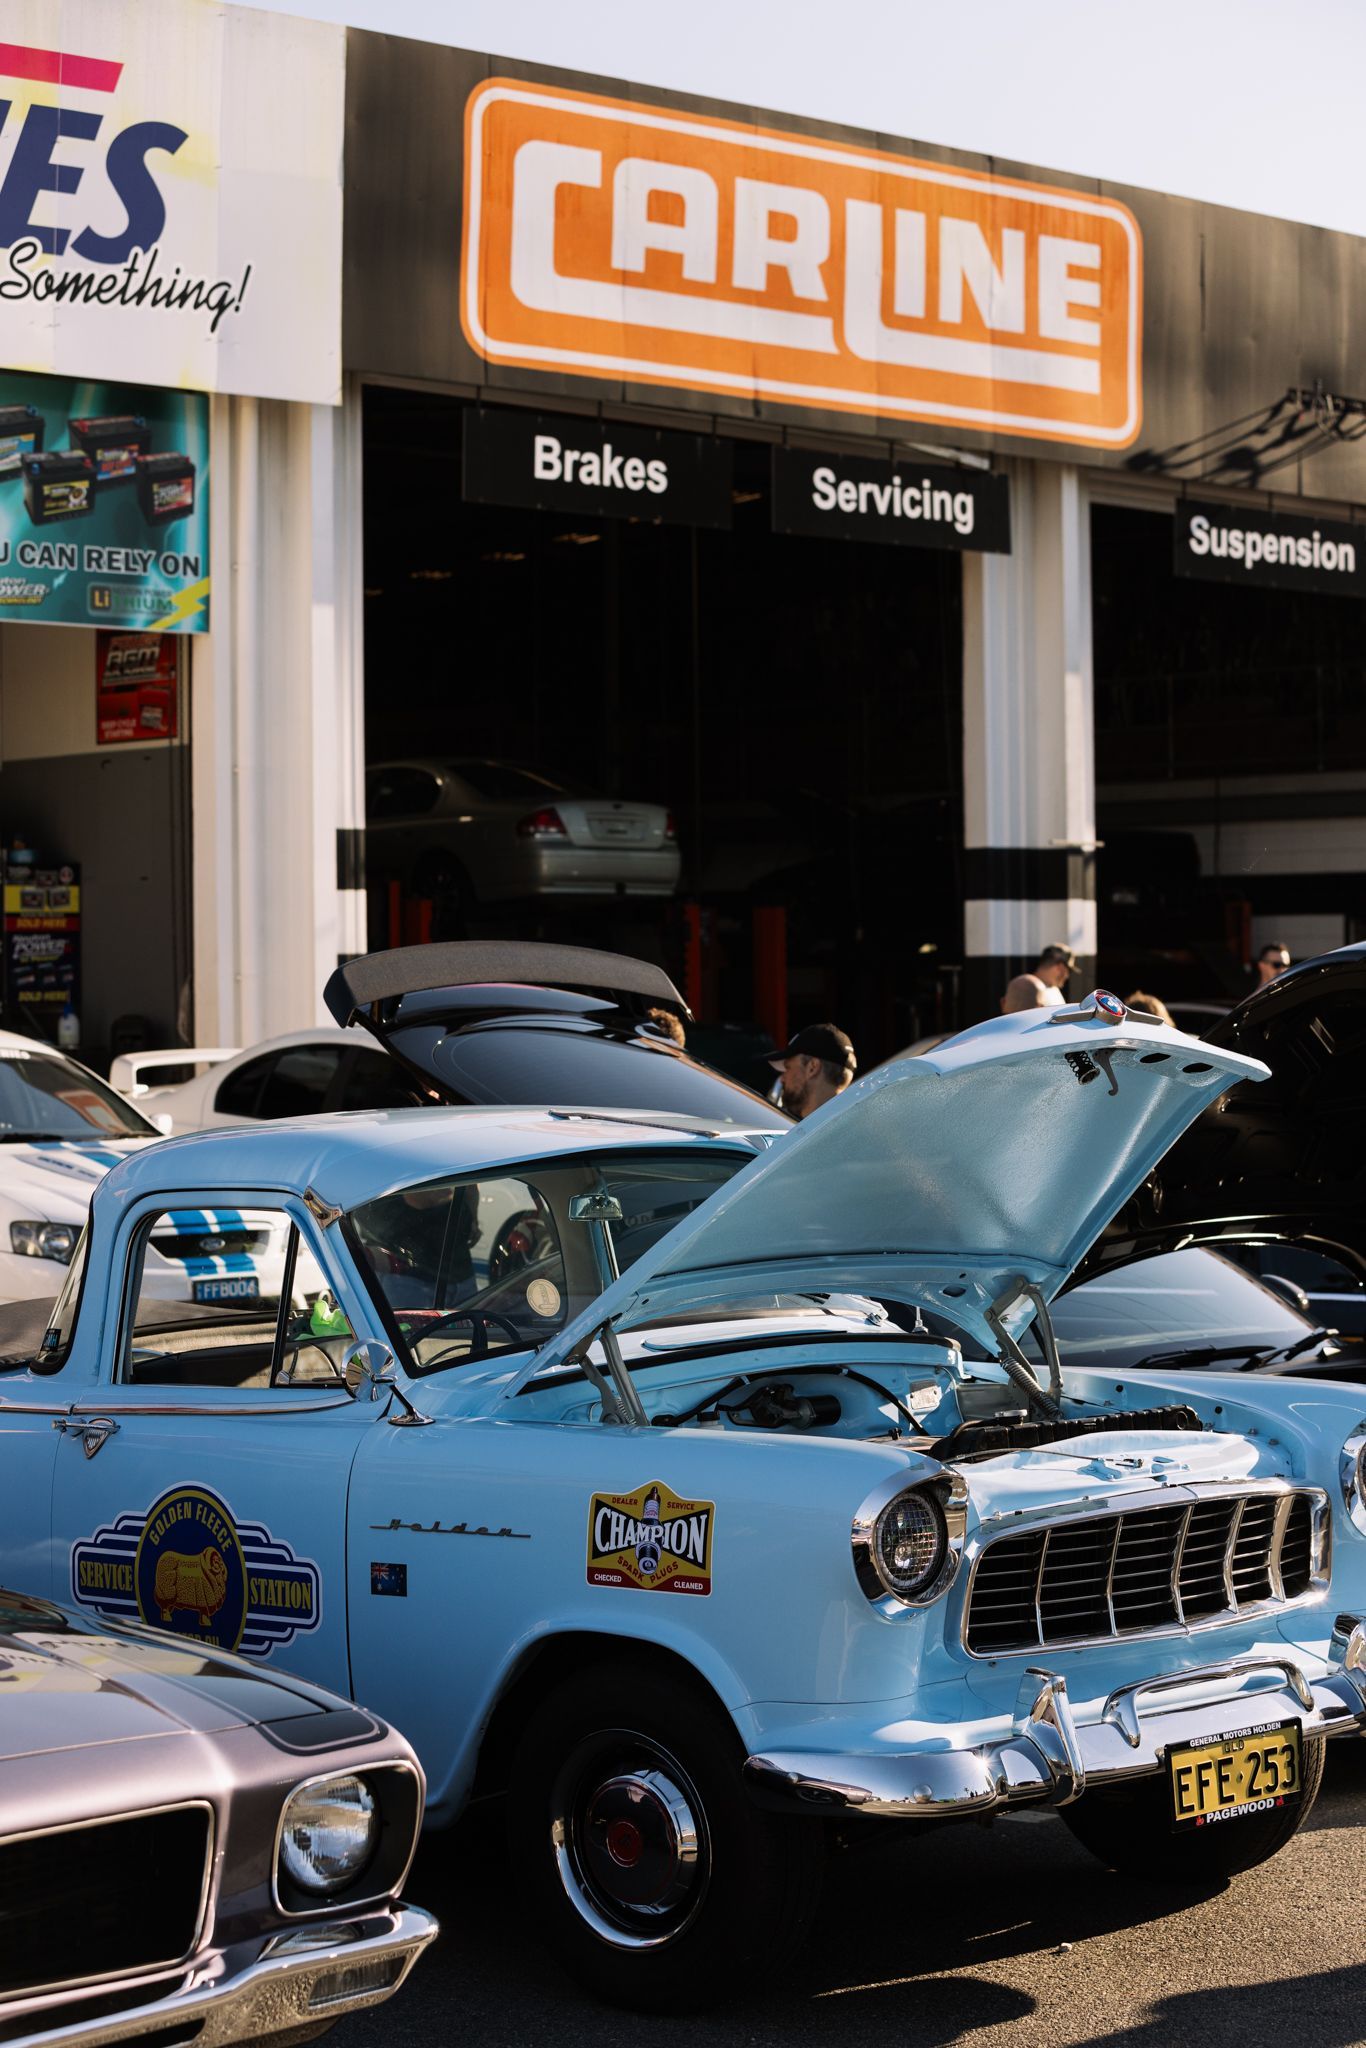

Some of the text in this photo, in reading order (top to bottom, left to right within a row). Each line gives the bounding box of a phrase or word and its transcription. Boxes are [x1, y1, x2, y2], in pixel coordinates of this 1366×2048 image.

[0, 98, 189, 264] ES
[0, 241, 251, 333] Something!
[510, 140, 1101, 395] CARLINE
[534, 434, 668, 494] Brakes
[812, 466, 974, 535] Servicing
[18, 541, 76, 569] CAN
[85, 547, 154, 576] RELY
[161, 552, 201, 578] ON
[1189, 515, 1356, 573] Suspension
[612, 1496, 695, 1511] DEALER SERVICE
[149, 1501, 232, 1552] GOLDEN FLEECE
[594, 1506, 708, 1564] CHAMPION
[79, 1560, 133, 1592] SERVICE
[594, 1573, 703, 1590] CHECKED CLEANED
[617, 1555, 679, 1583] SPARK PLUGS
[250, 1578, 312, 1611] STATION
[1189, 1721, 1281, 1748] GENERAL MOTORS HOLDEN
[1206, 1798, 1275, 1823] PAGEWOOD
